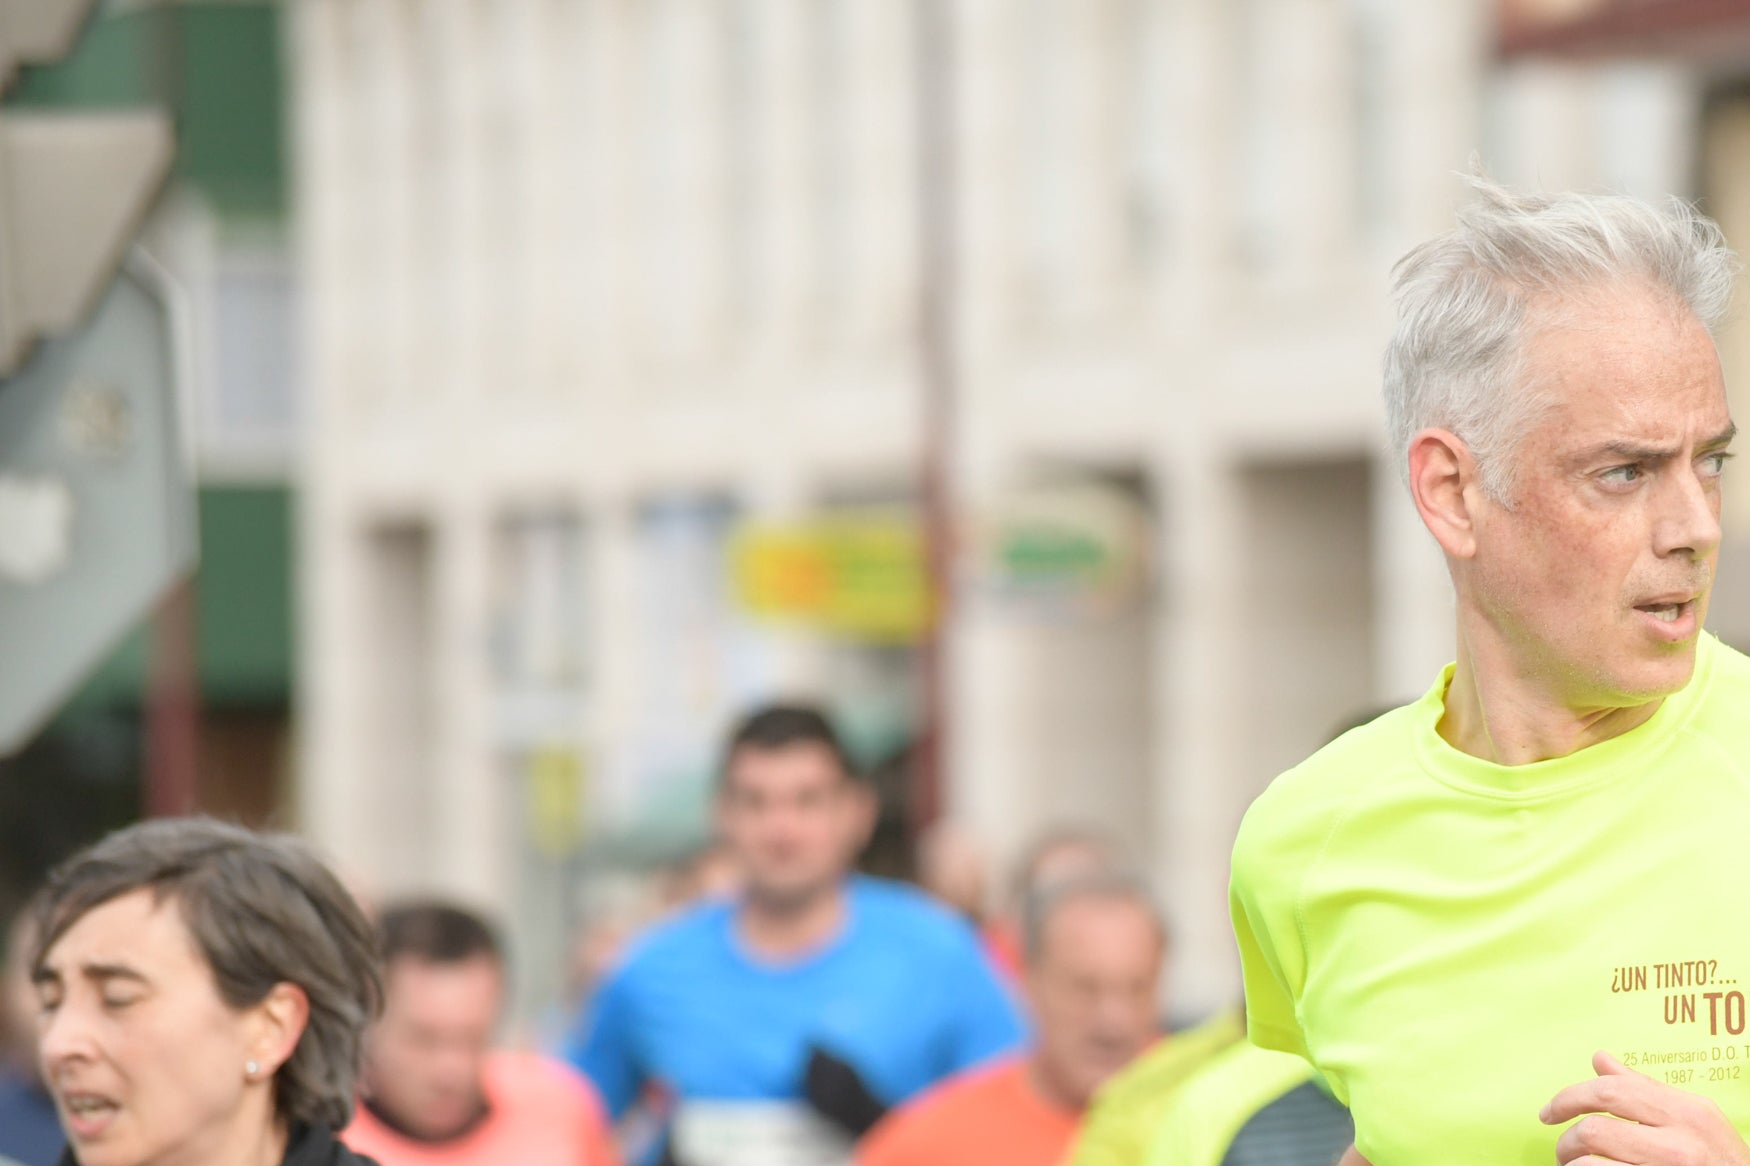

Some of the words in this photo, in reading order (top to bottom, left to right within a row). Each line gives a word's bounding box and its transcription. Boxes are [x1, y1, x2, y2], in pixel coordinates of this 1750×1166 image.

[1611, 966, 1647, 993] ¿UN
[1653, 959, 1737, 989] TINTO?...
[1664, 994, 1696, 1025] UN
[1623, 1052, 1638, 1067] 25
[1641, 1050, 1707, 1066] Aniversario
[1711, 1045, 1739, 1062] D.O.
[1664, 1069, 1694, 1085] 1987
[1709, 1066, 1741, 1082] 2012
